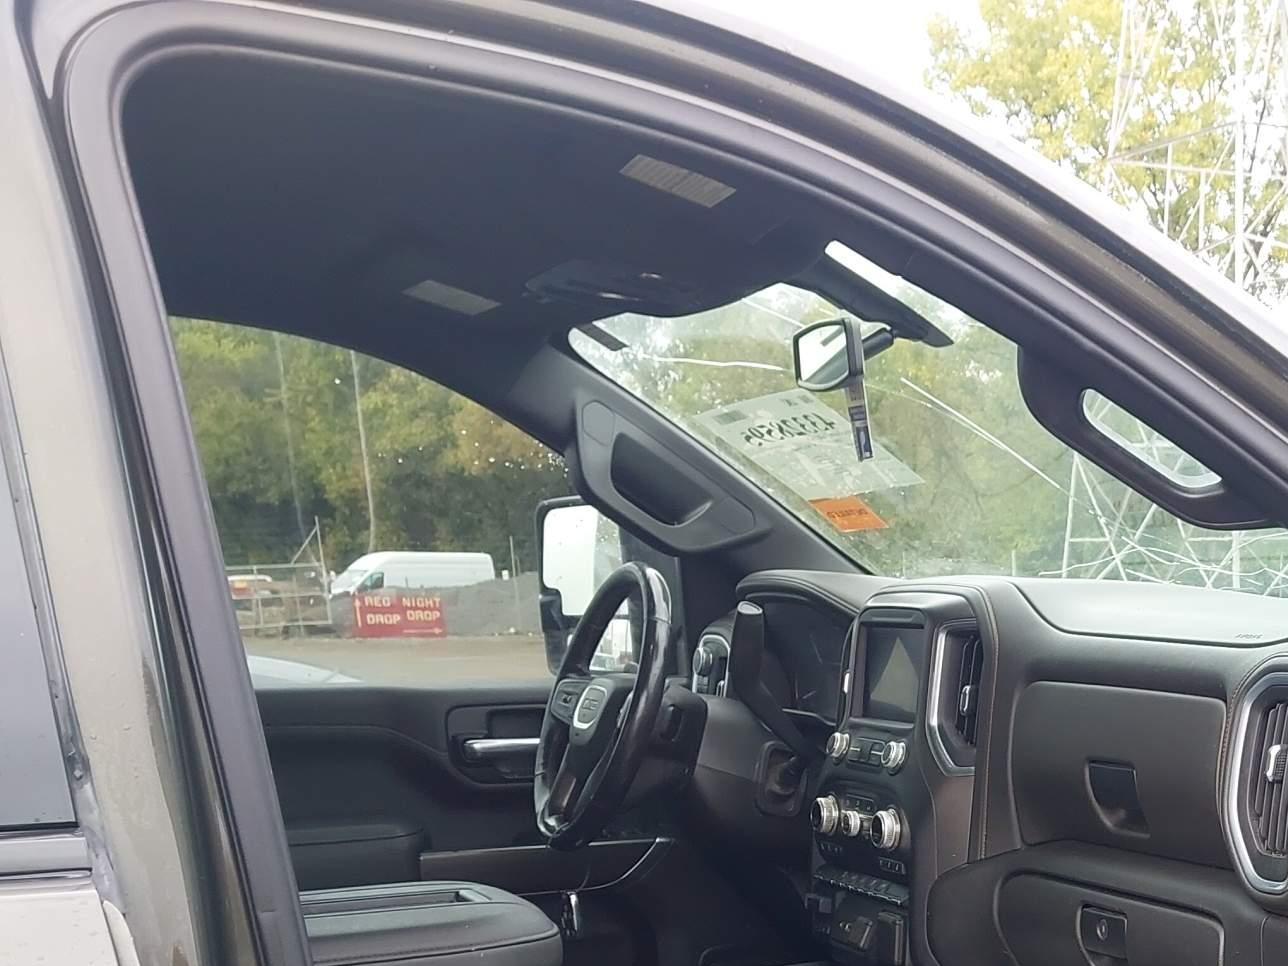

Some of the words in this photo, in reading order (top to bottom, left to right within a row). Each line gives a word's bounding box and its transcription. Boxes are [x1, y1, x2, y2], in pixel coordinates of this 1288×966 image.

[402, 597, 441, 608] NIGHT
[366, 613, 401, 625] DROP
[406, 610, 441, 621] DROP
